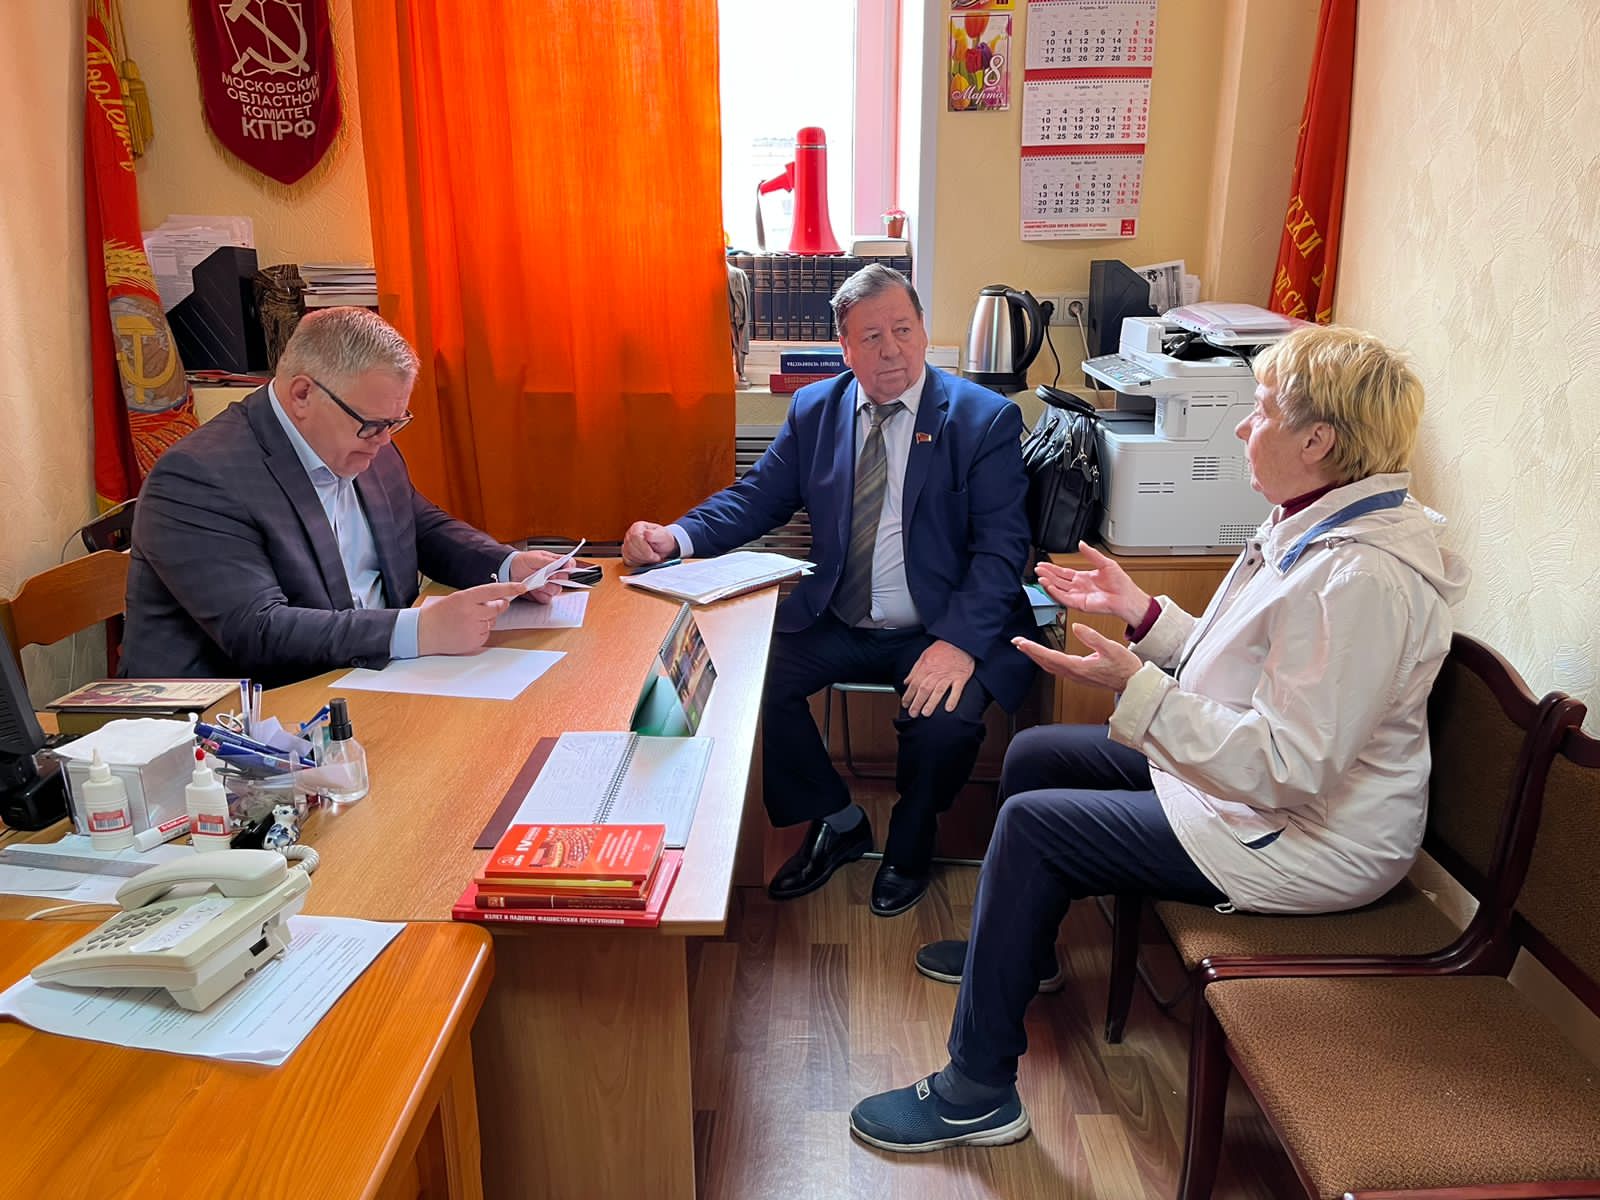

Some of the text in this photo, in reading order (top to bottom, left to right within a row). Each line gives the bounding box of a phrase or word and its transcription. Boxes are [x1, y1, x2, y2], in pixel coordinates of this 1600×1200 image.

[984, 54, 1005, 86] 8
[222, 72, 320, 94] МОСКОВСКИЙ
[227, 88, 320, 107] ОБЛАСТНОЙ
[242, 104, 312, 120] КОМИТЕТ
[242, 116, 316, 140] КПРФ
